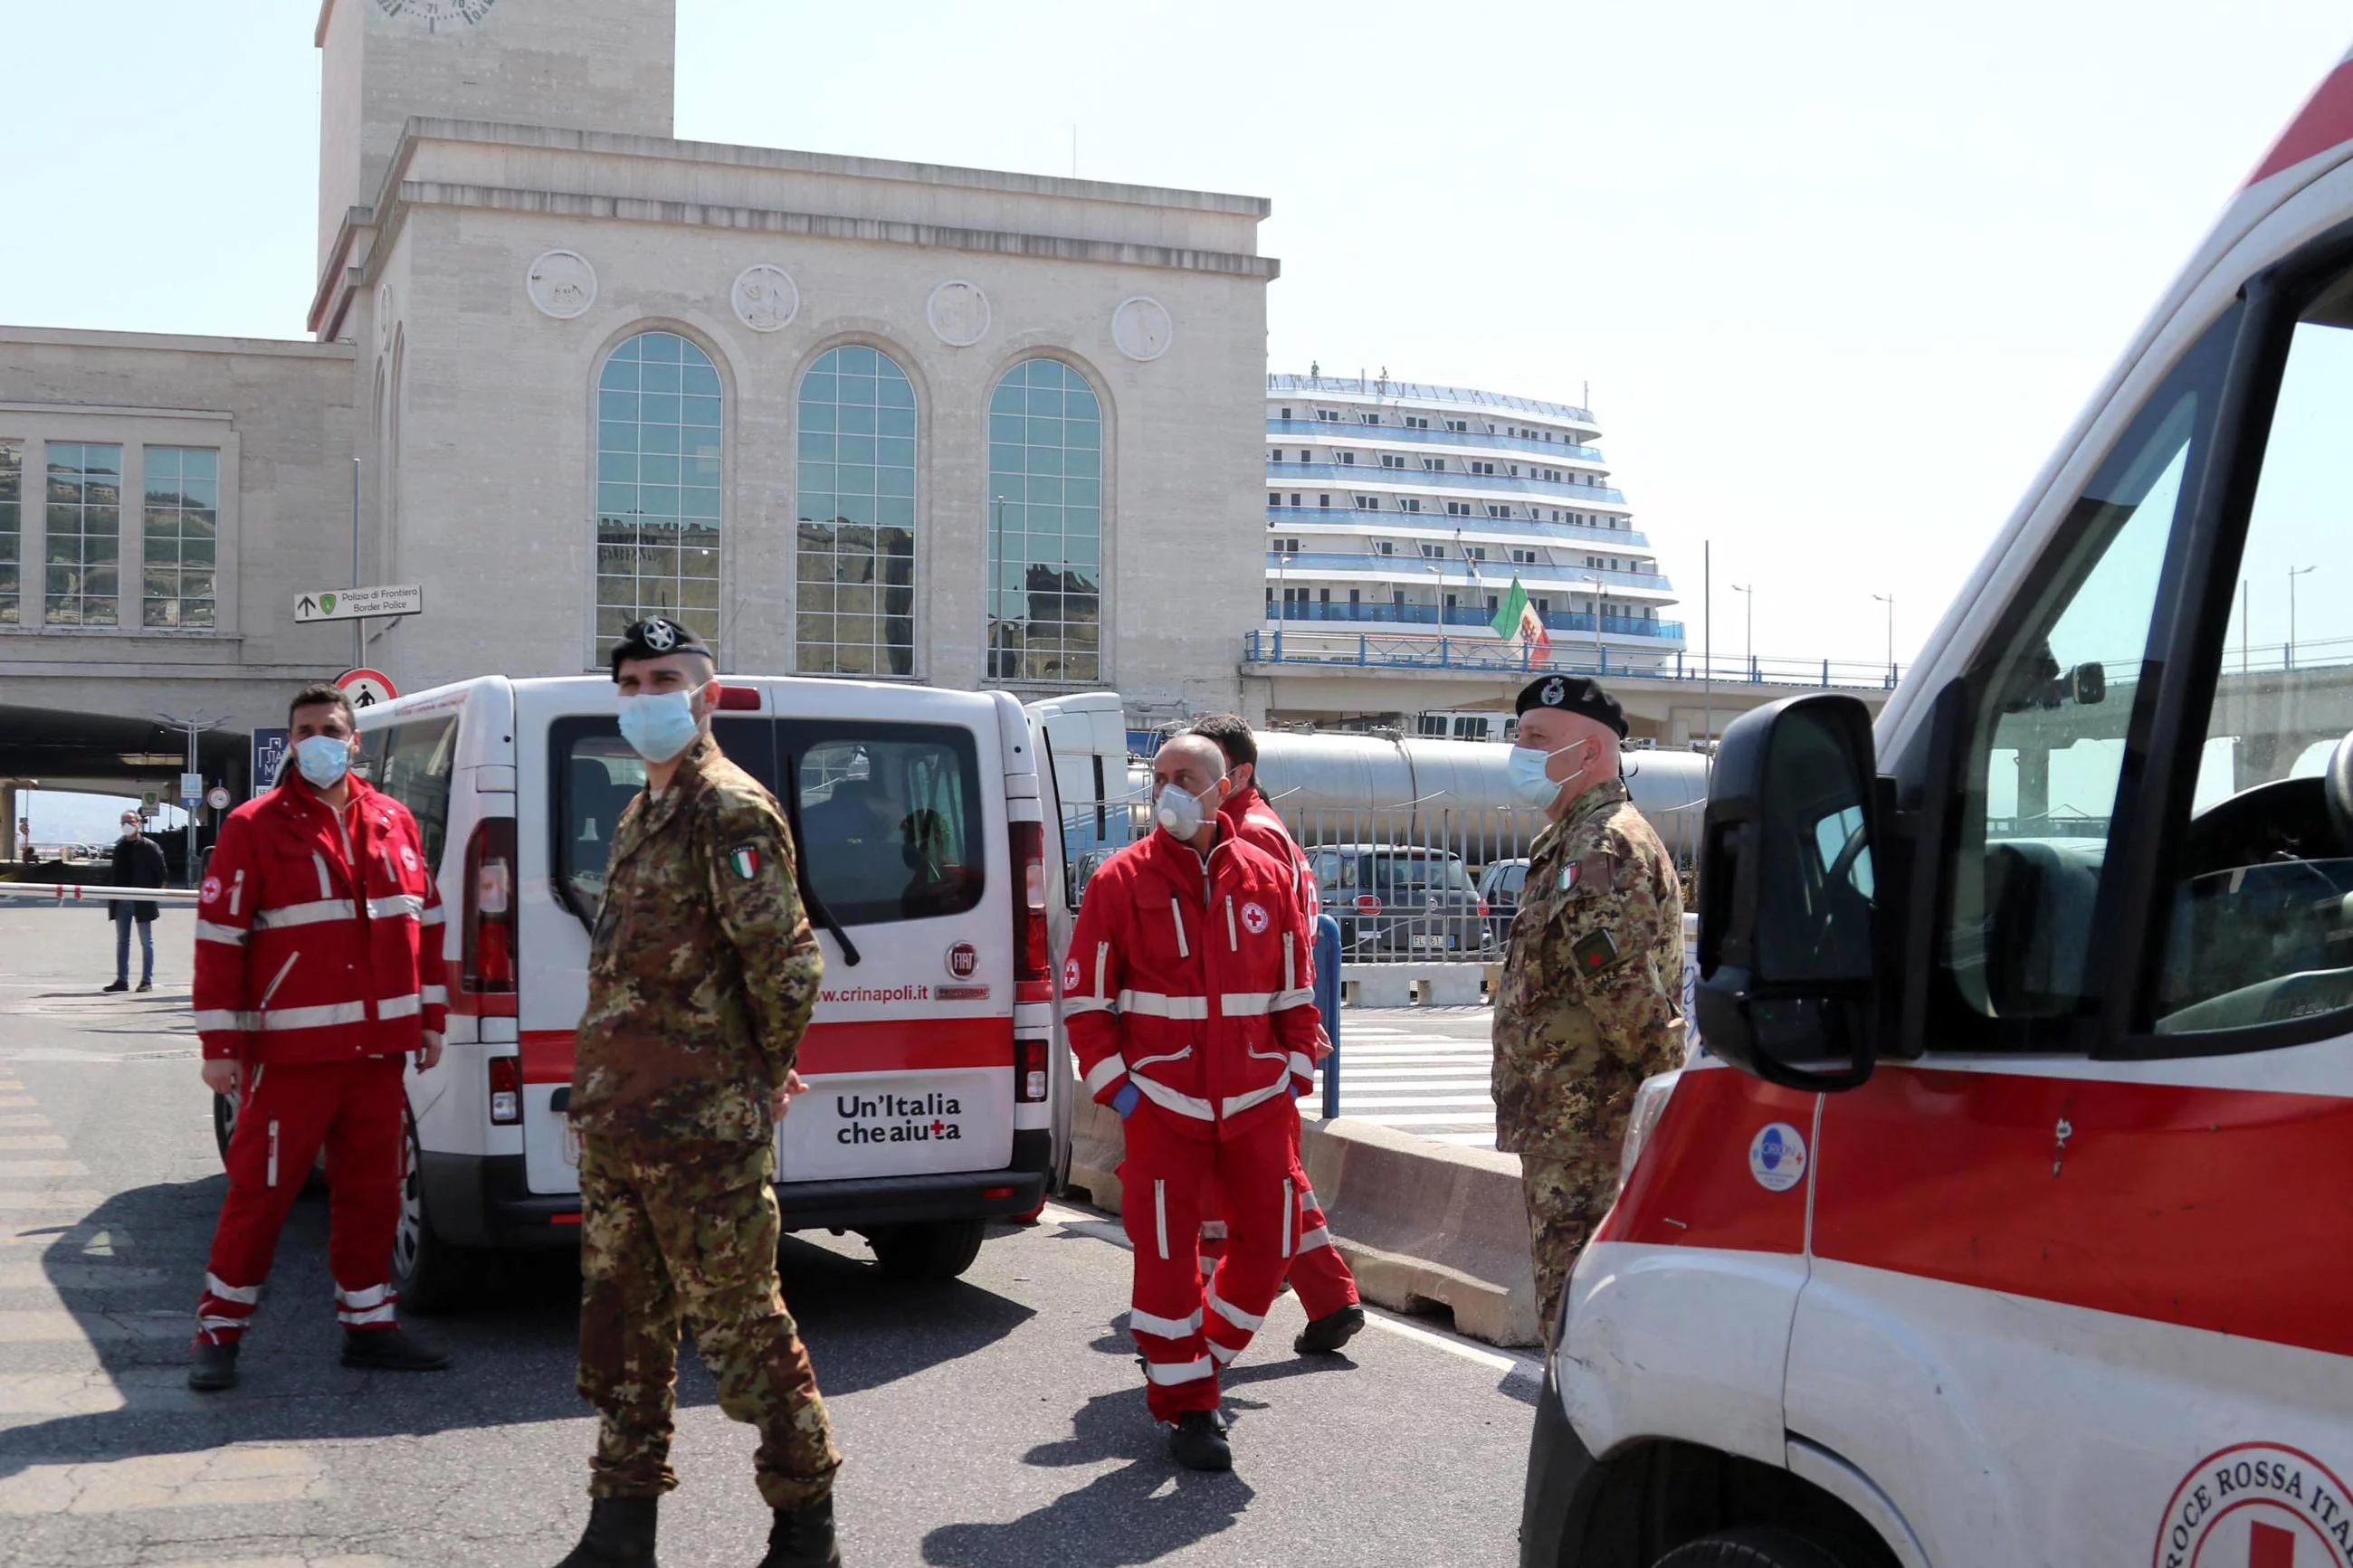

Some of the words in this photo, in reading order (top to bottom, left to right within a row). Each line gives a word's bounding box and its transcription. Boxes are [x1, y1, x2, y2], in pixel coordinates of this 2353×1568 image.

[342, 592, 369, 601] Polizia
[370, 591, 378, 599] di
[380, 588, 417, 597] Frontiera
[354, 603, 380, 612] Border
[383, 601, 406, 609] Police
[954, 952, 974, 970] FIAT
[816, 985, 928, 1005] w.crinapoli.it
[2215, 1460, 2303, 1499] ROSSA
